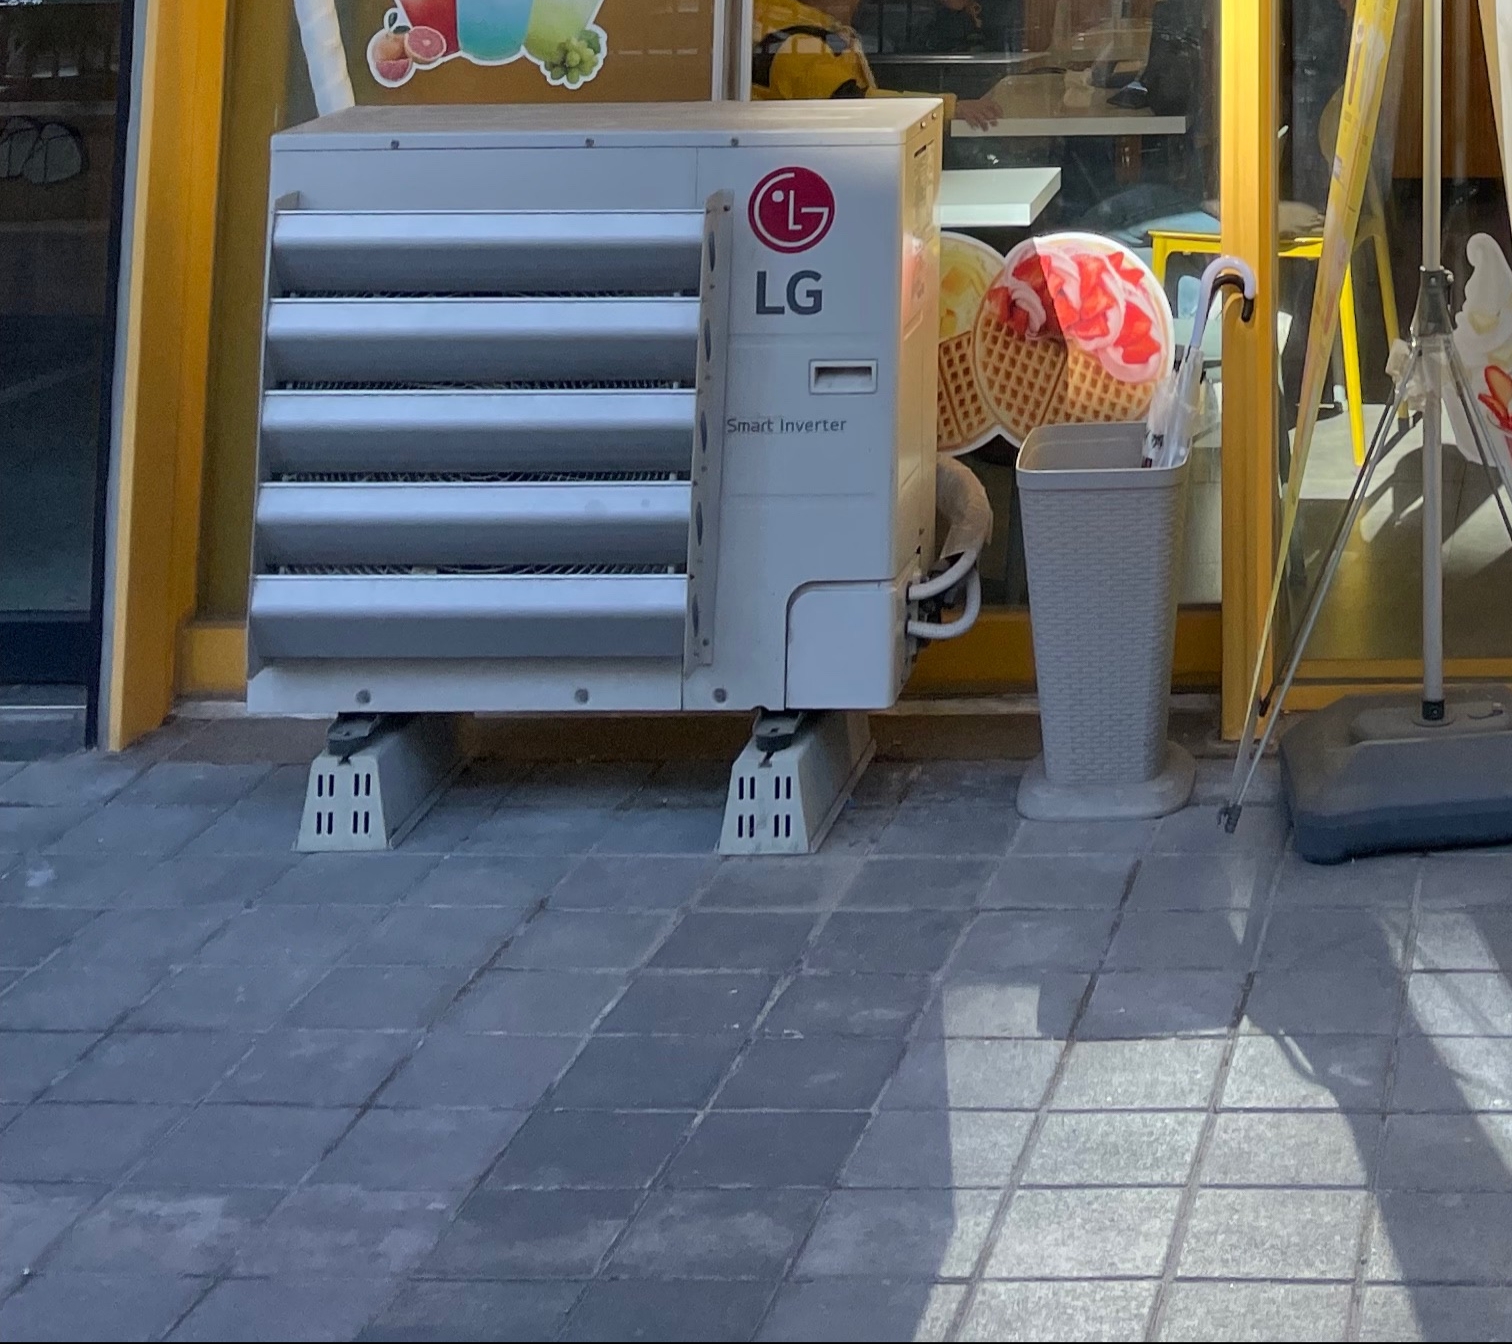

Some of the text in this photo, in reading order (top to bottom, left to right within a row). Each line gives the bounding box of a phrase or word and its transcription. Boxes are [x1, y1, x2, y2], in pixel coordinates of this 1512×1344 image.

[756, 270, 823, 315] LG
[726, 418, 847, 433] Smart Inverter
